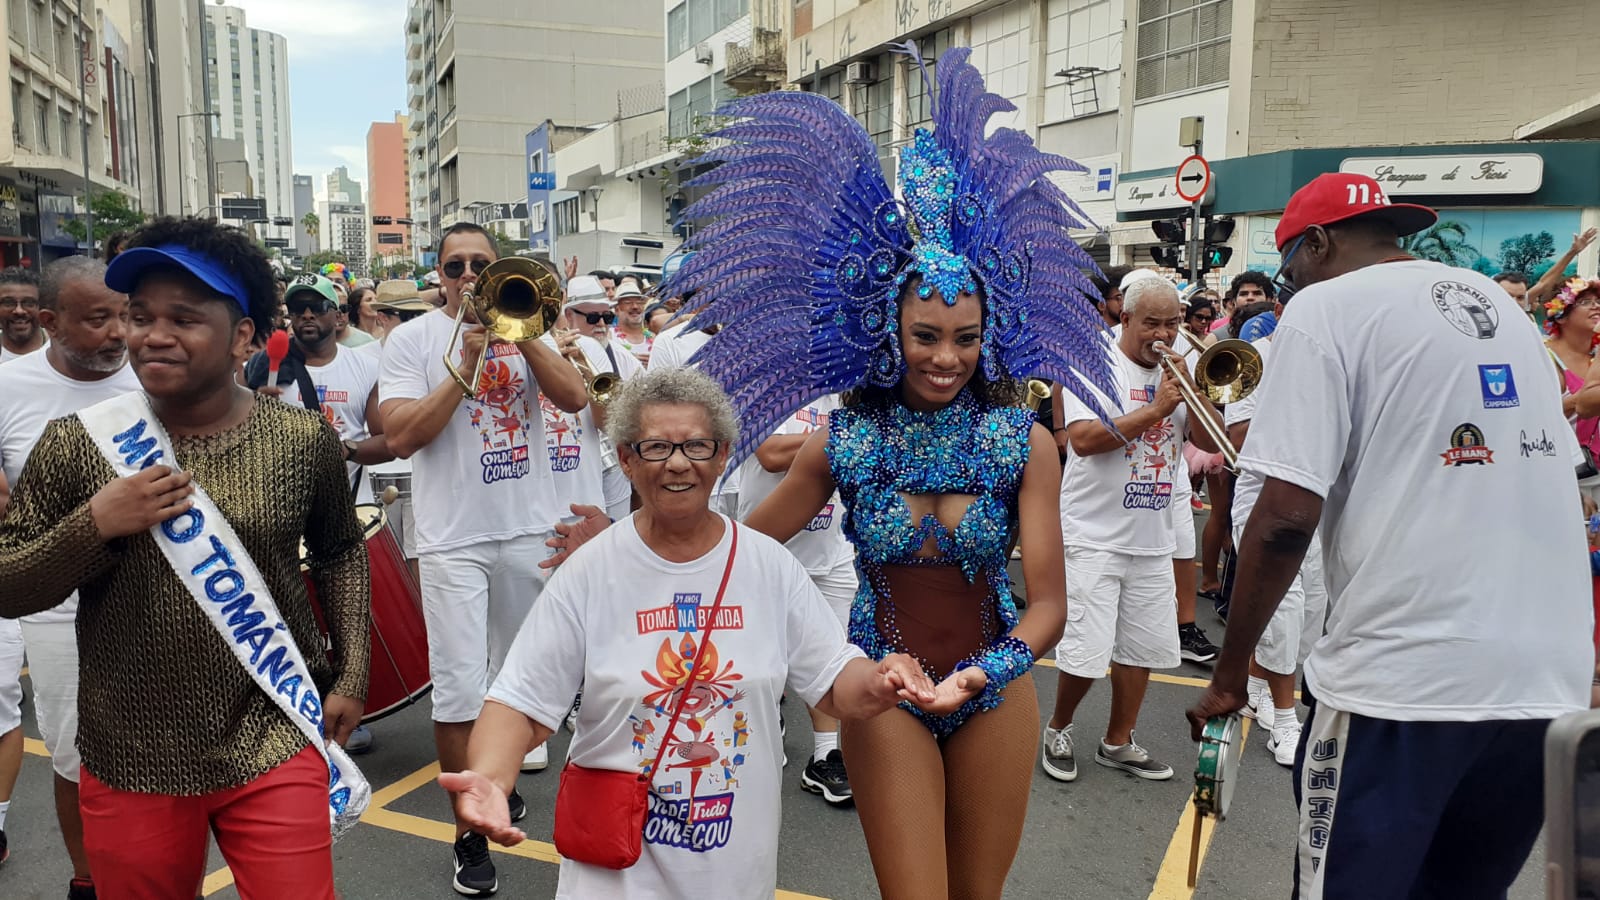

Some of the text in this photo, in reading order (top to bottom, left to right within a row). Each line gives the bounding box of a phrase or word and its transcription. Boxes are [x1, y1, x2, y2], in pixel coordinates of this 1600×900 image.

[1441, 165, 1461, 180] di
[1471, 160, 1512, 180] Fiori
[482, 450, 513, 466] ONDE
[1461, 448, 1488, 458] MANS
[638, 604, 677, 633] TOMÁ
[678, 608, 697, 629] NA
[693, 800, 728, 821] Tudo
[645, 817, 730, 849] OMEÇOU
